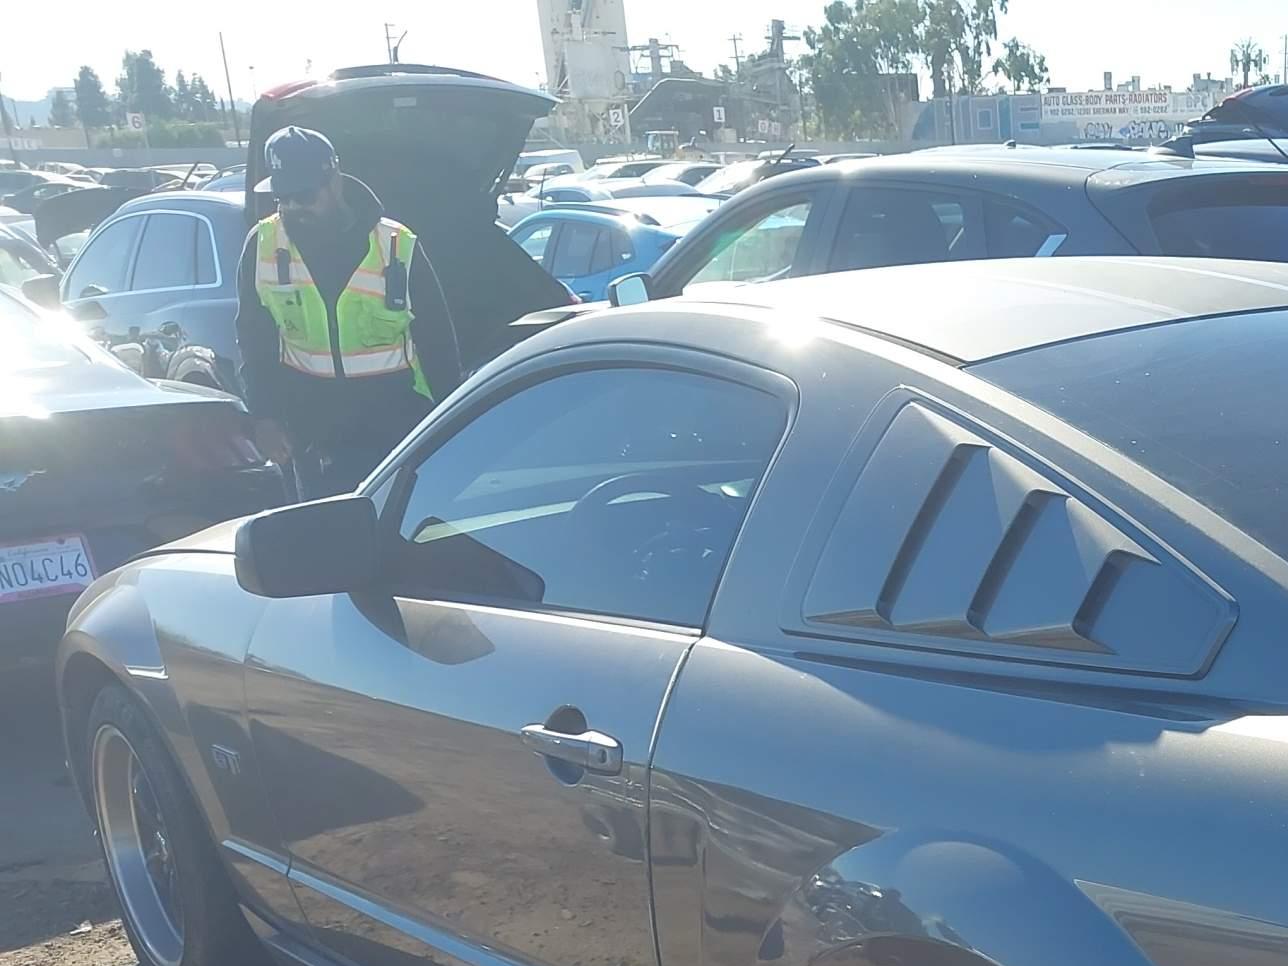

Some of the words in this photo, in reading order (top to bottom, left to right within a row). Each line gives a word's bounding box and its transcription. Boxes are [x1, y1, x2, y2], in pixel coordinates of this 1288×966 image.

[1043, 95, 1060, 106] AUTO
[132, 115, 142, 129] 6
[612, 111, 620, 123] 2
